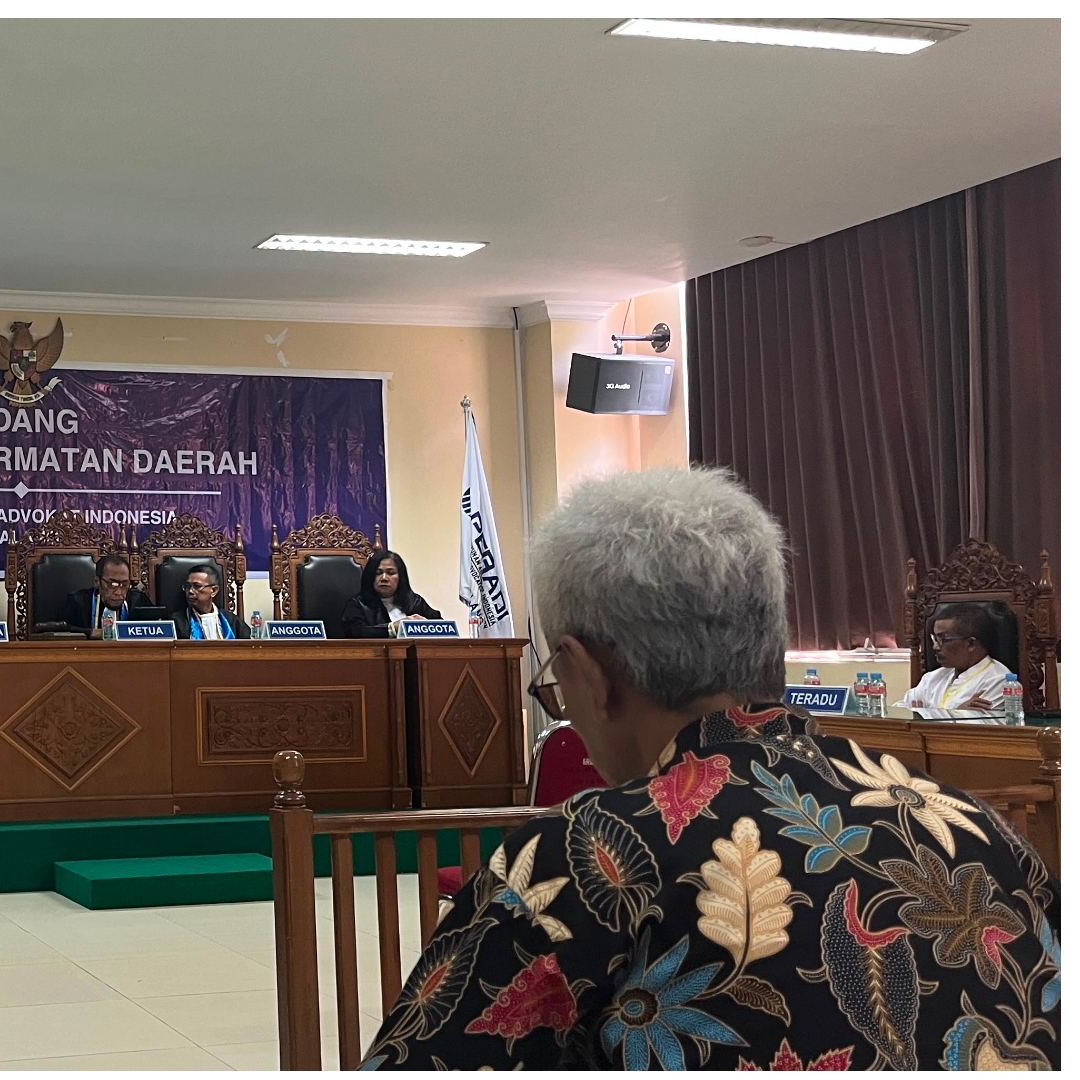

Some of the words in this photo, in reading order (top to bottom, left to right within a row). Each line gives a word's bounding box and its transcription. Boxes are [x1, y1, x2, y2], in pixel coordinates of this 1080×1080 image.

[133, 449, 258, 476] DAERAH
[470, 511, 510, 622] PERADI
[128, 626, 164, 636] KETUA
[271, 626, 322, 635] ANGGOTA
[407, 625, 456, 634] ANGGOTA
[790, 692, 838, 706] TERADU
